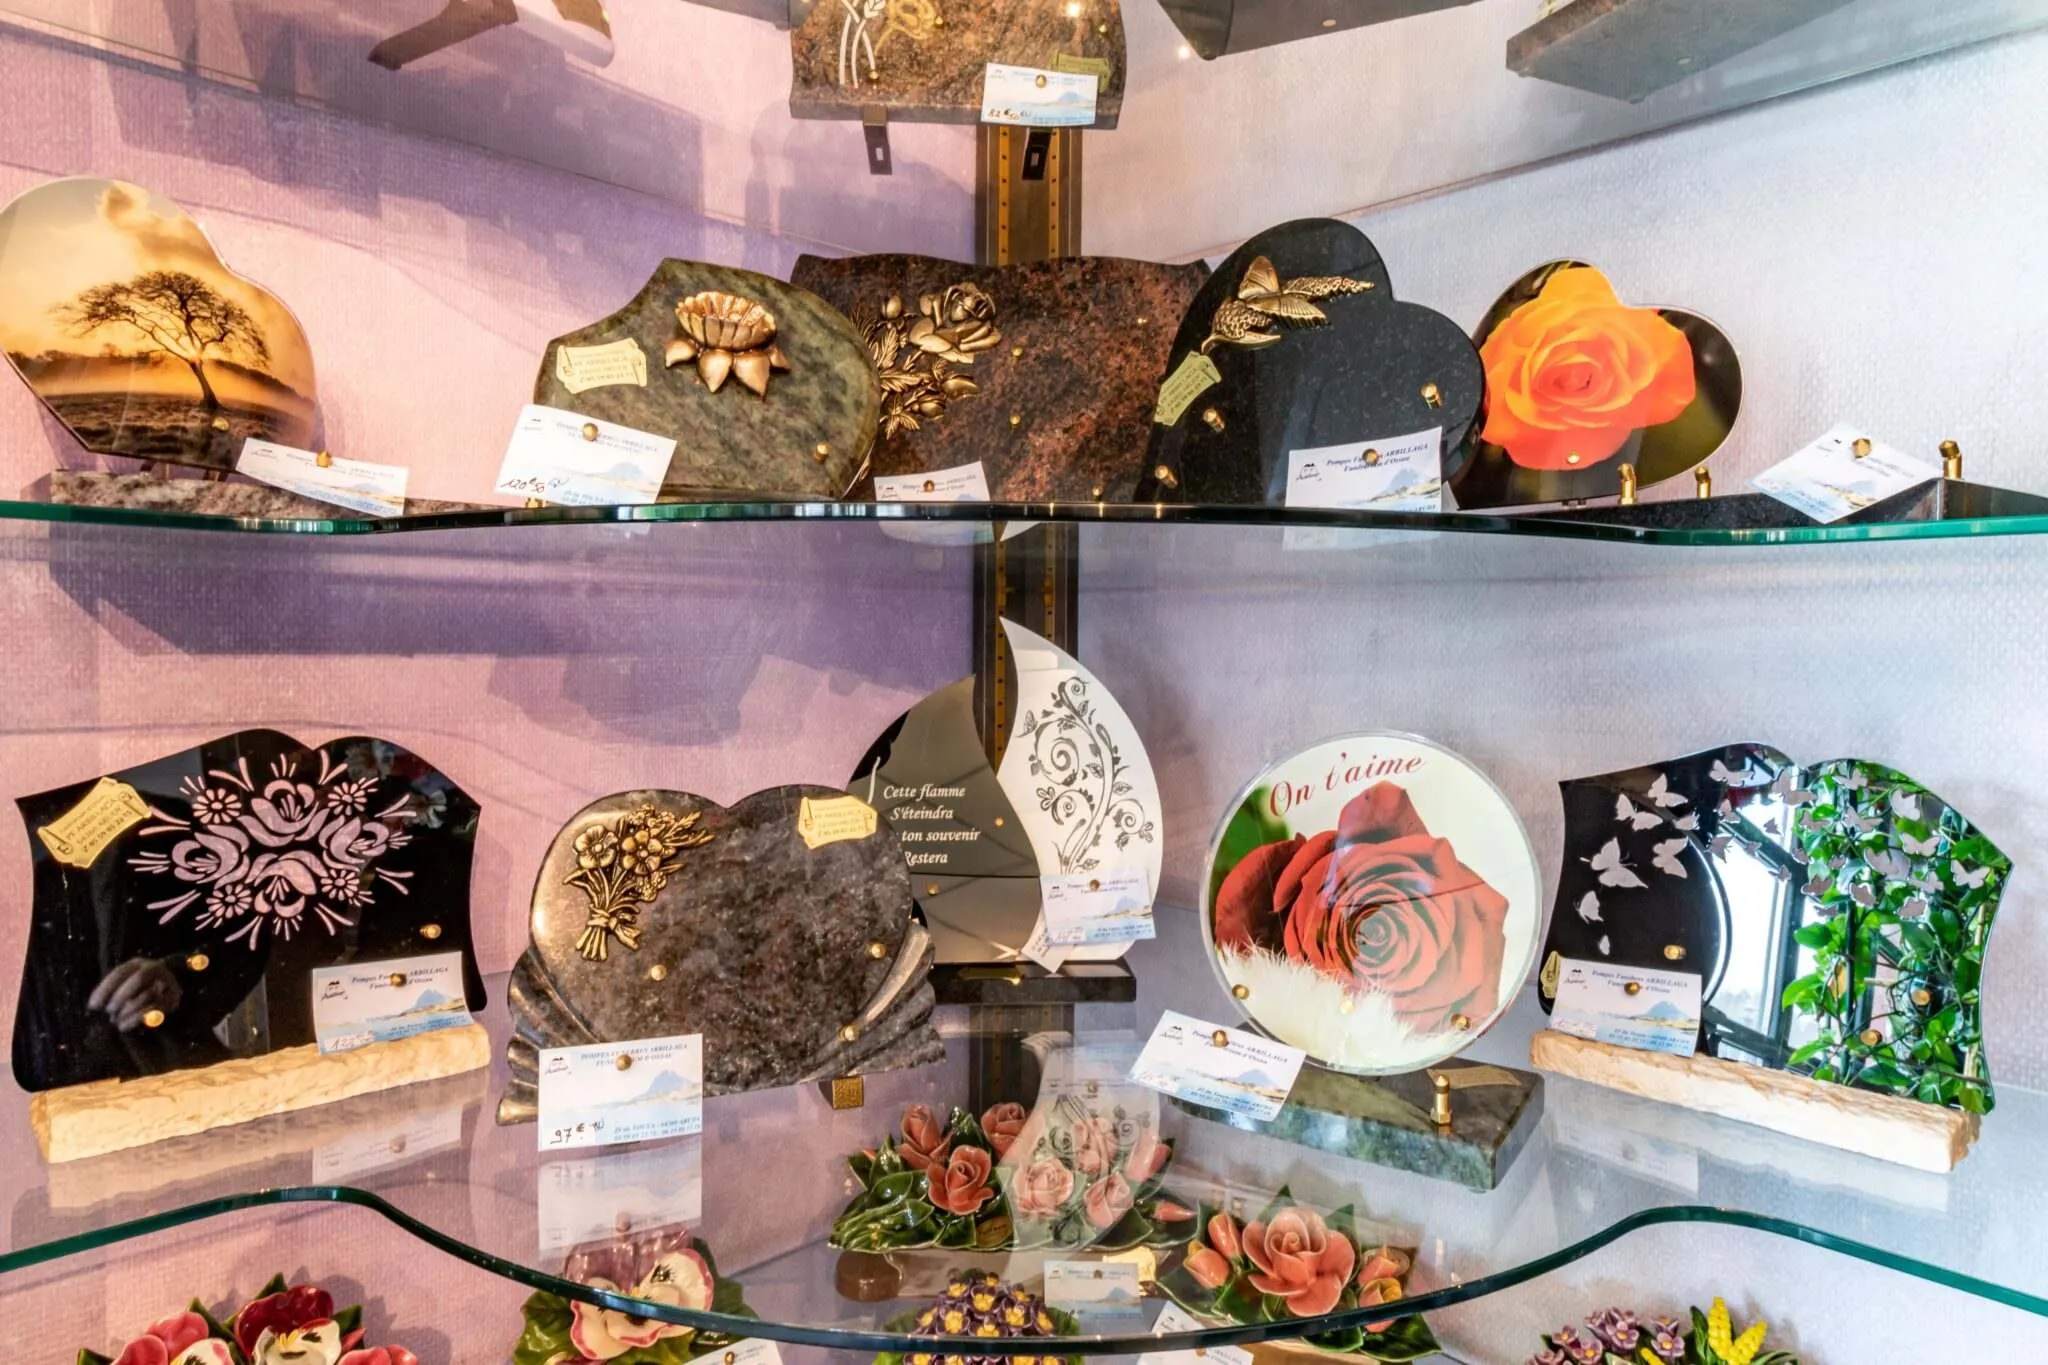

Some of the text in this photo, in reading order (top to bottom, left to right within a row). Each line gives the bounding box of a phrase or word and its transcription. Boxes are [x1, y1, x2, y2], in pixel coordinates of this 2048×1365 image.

[883, 783, 966, 802] Cette flamme
[1270, 752, 1424, 817] On t'aime
[890, 804, 954, 820] S'éteindra
[901, 827, 982, 842] ton souvenir
